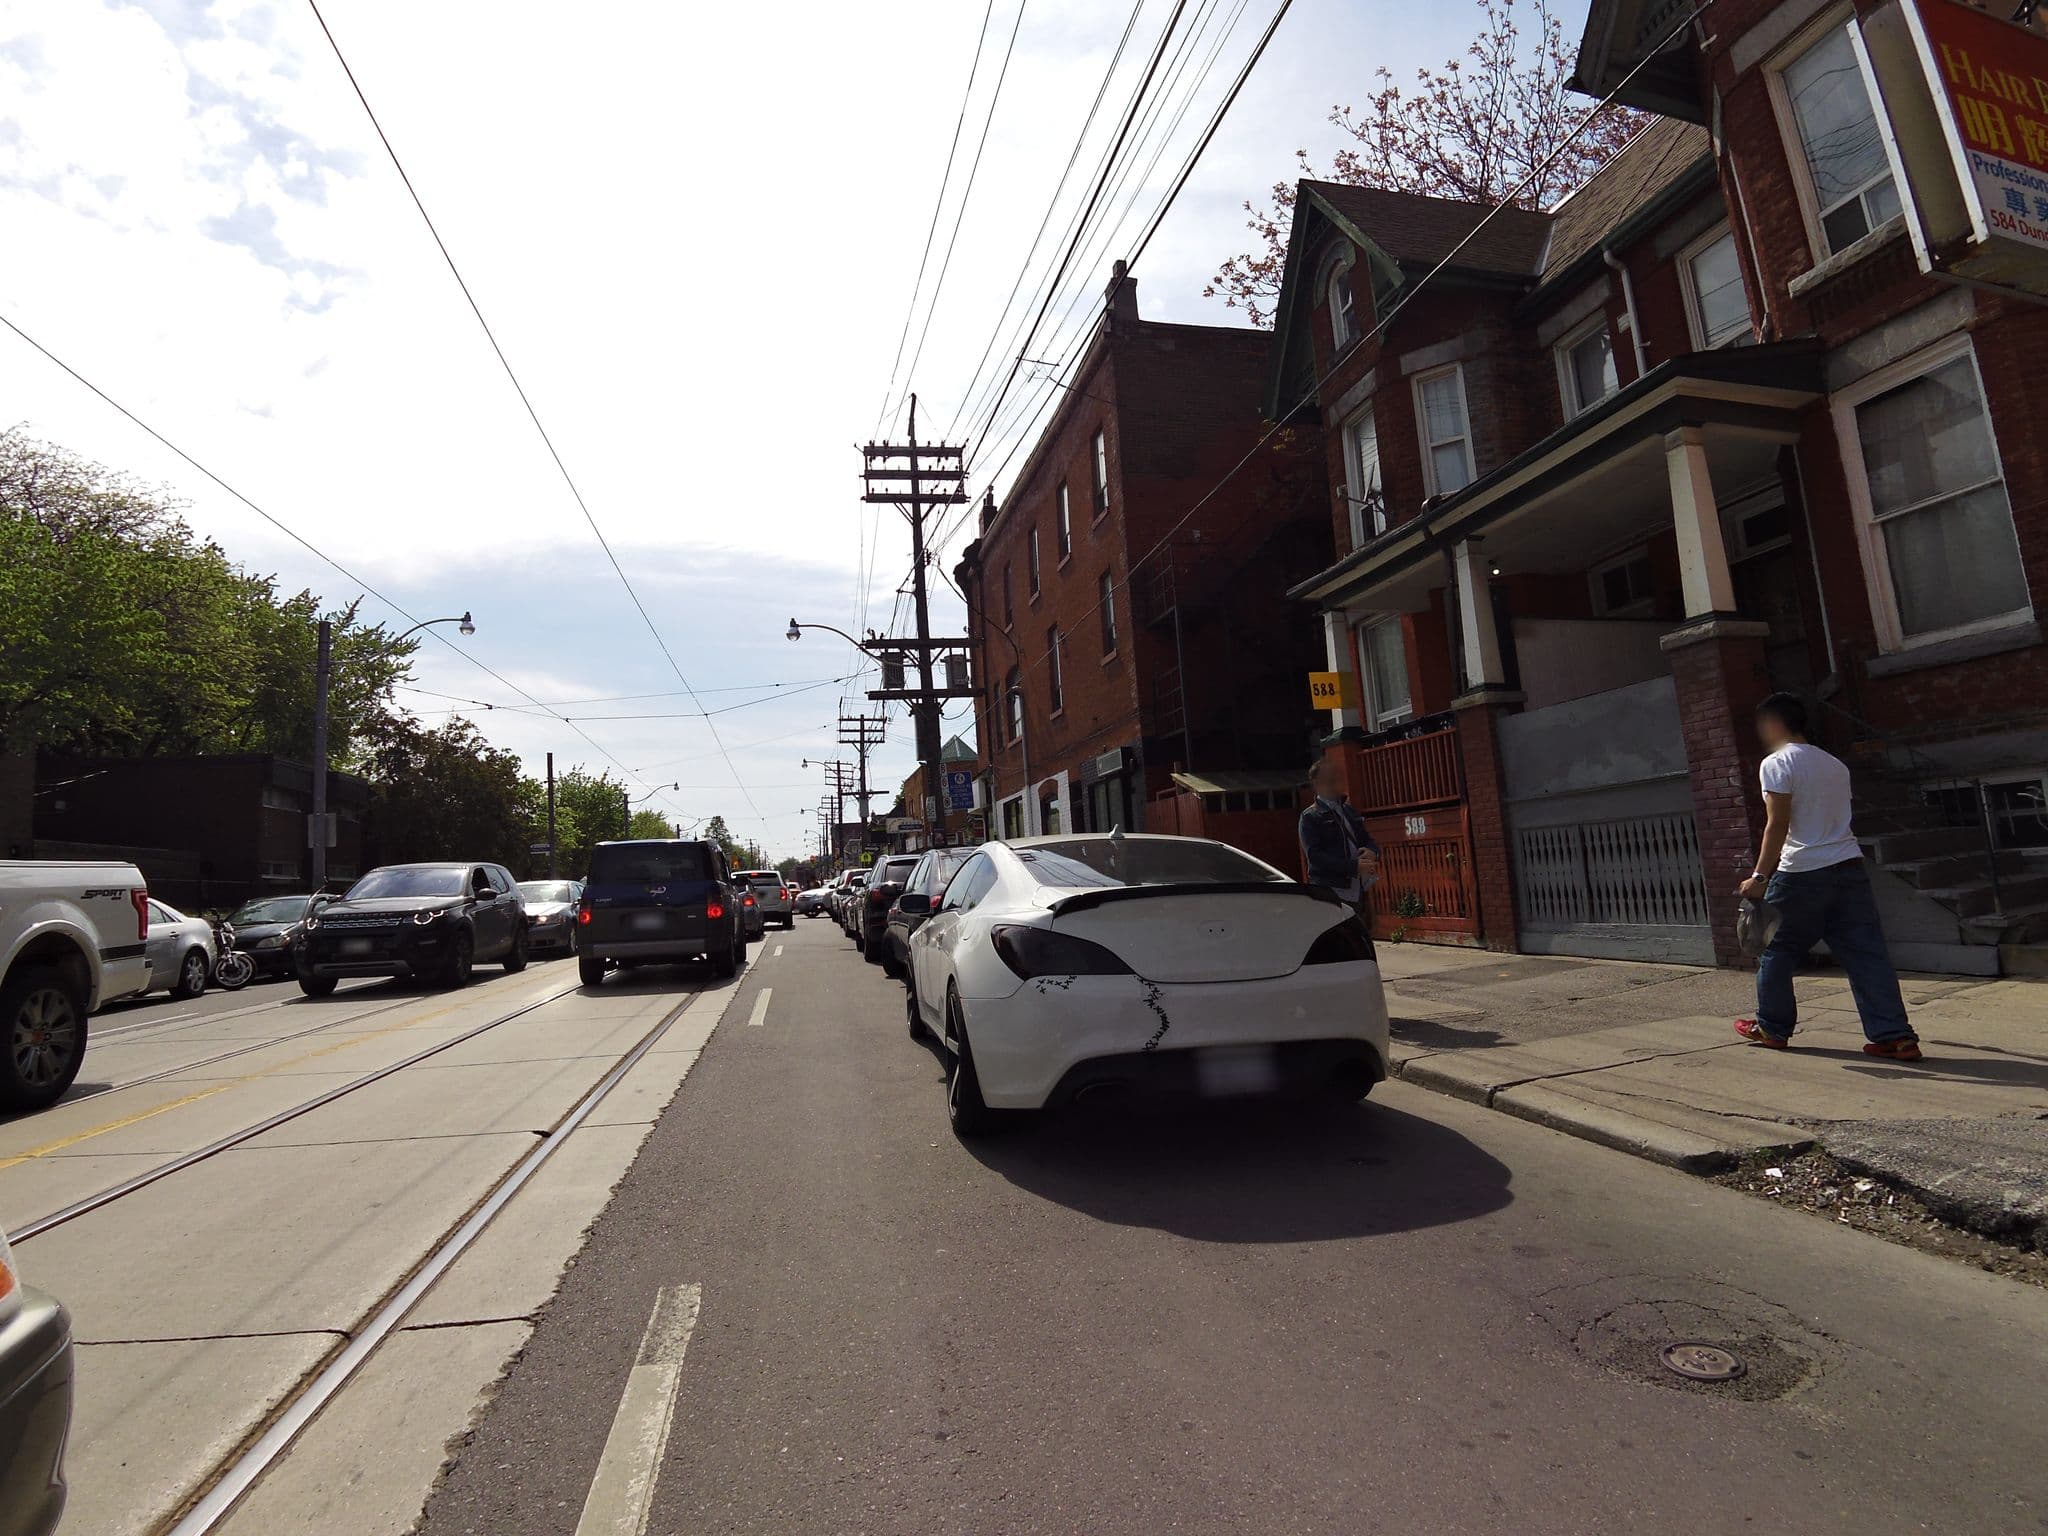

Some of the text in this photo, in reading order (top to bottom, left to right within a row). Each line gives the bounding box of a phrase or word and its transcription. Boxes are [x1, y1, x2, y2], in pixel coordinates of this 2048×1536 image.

[1990, 209, 2017, 232] 584
[1313, 683, 1335, 696] 588
[1405, 816, 1425, 835] 588
[81, 889, 127, 899] SPORT
